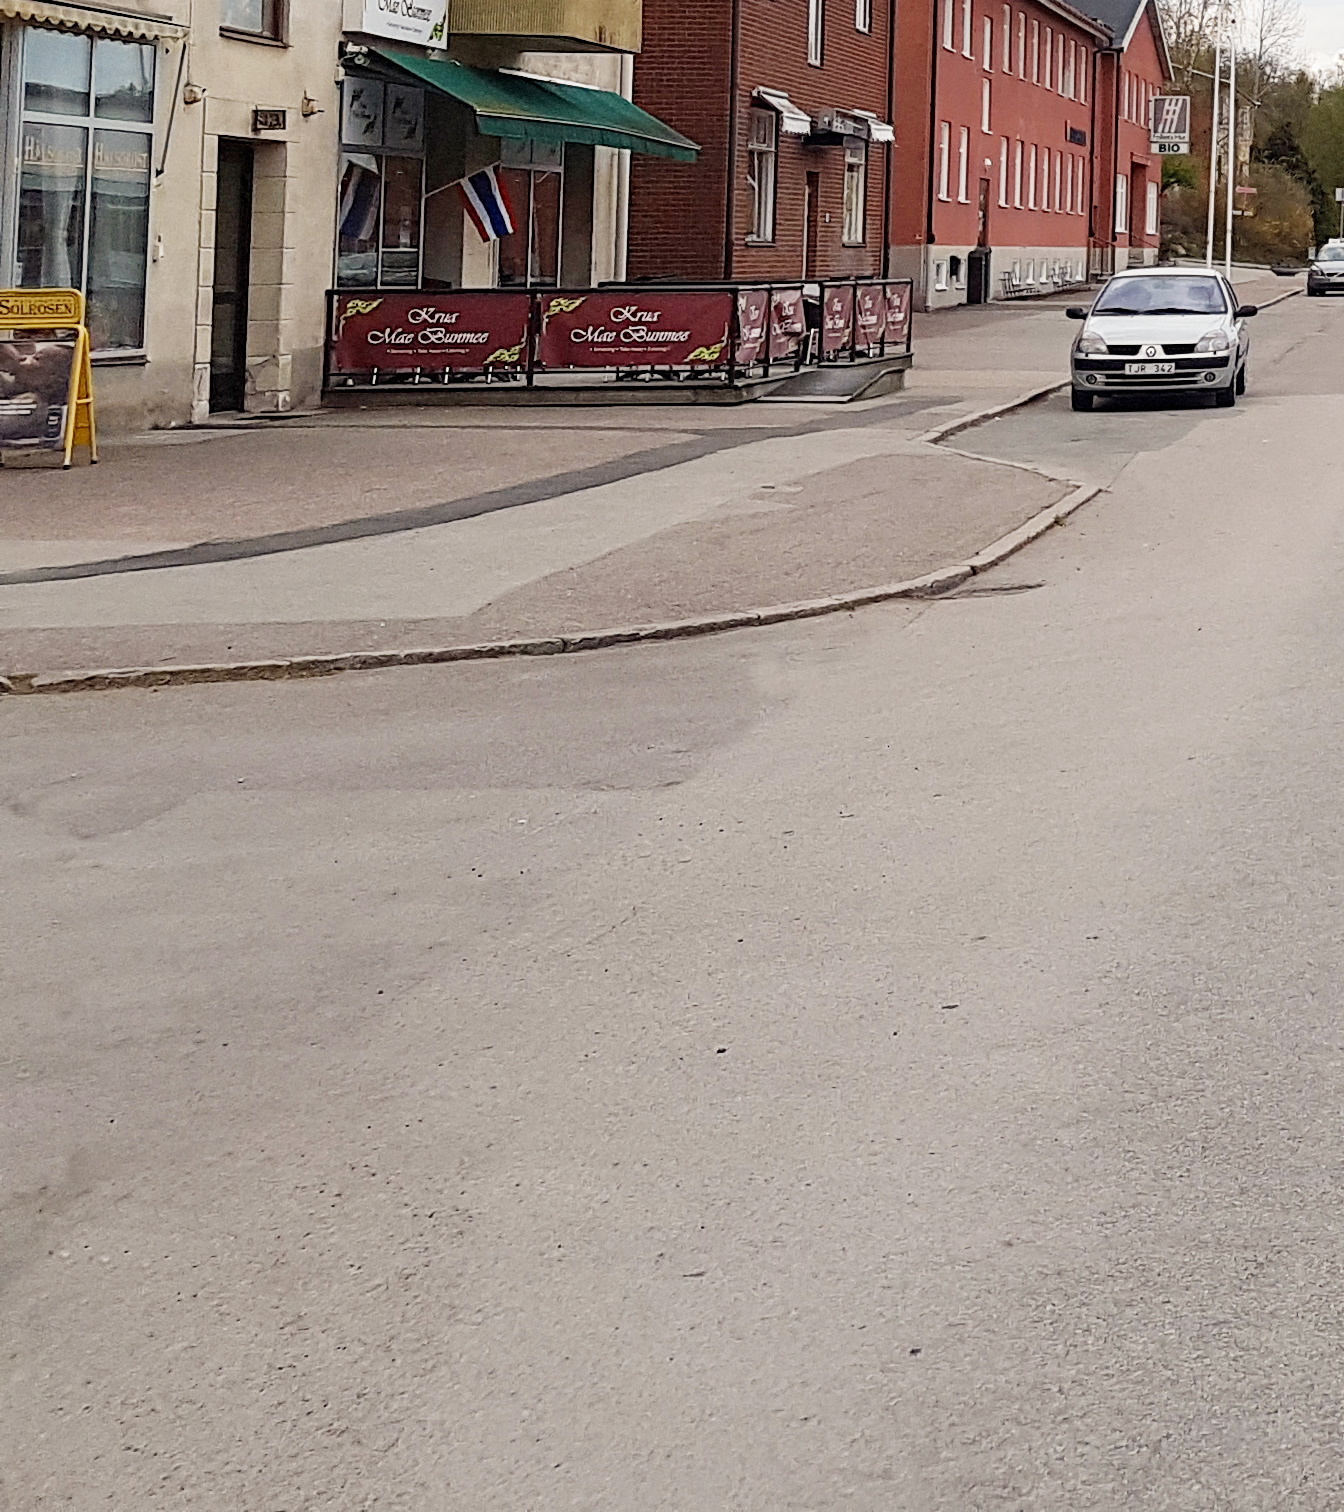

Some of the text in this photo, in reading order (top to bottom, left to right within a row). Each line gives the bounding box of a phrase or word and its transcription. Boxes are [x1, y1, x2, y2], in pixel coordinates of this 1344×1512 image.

[1158, 143, 1181, 153] BIO
[408, 307, 460, 324] Krua
[367, 327, 490, 344] Mae Bunmee
[570, 325, 617, 342] Mae
[1128, 364, 1173, 372] TJR 342
